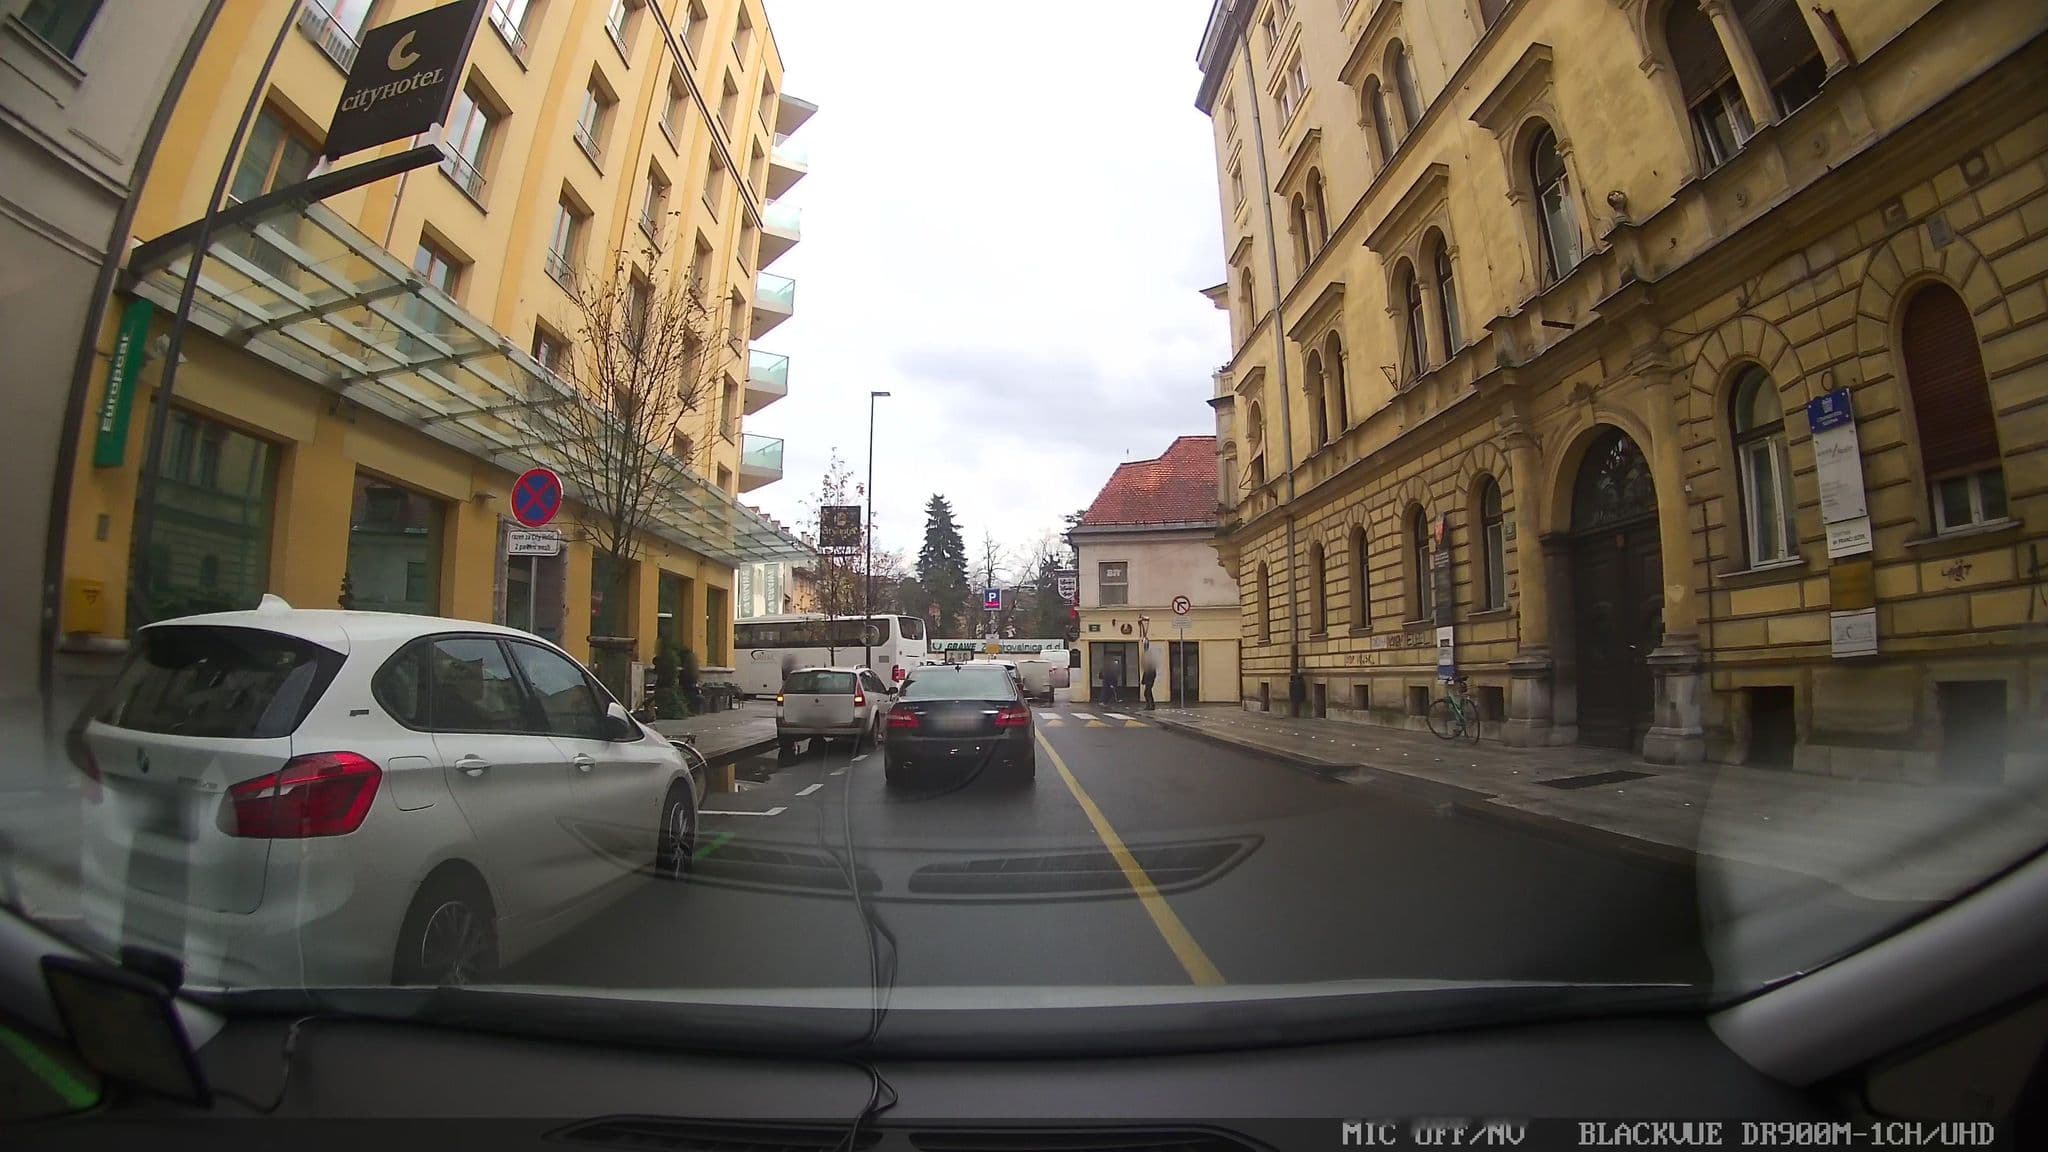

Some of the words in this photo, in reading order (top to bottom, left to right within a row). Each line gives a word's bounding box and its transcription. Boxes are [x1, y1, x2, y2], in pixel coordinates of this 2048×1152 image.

[101, 332, 129, 432] Europcar
[988, 592, 997, 602] P
[947, 642, 976, 650] GRAWE
